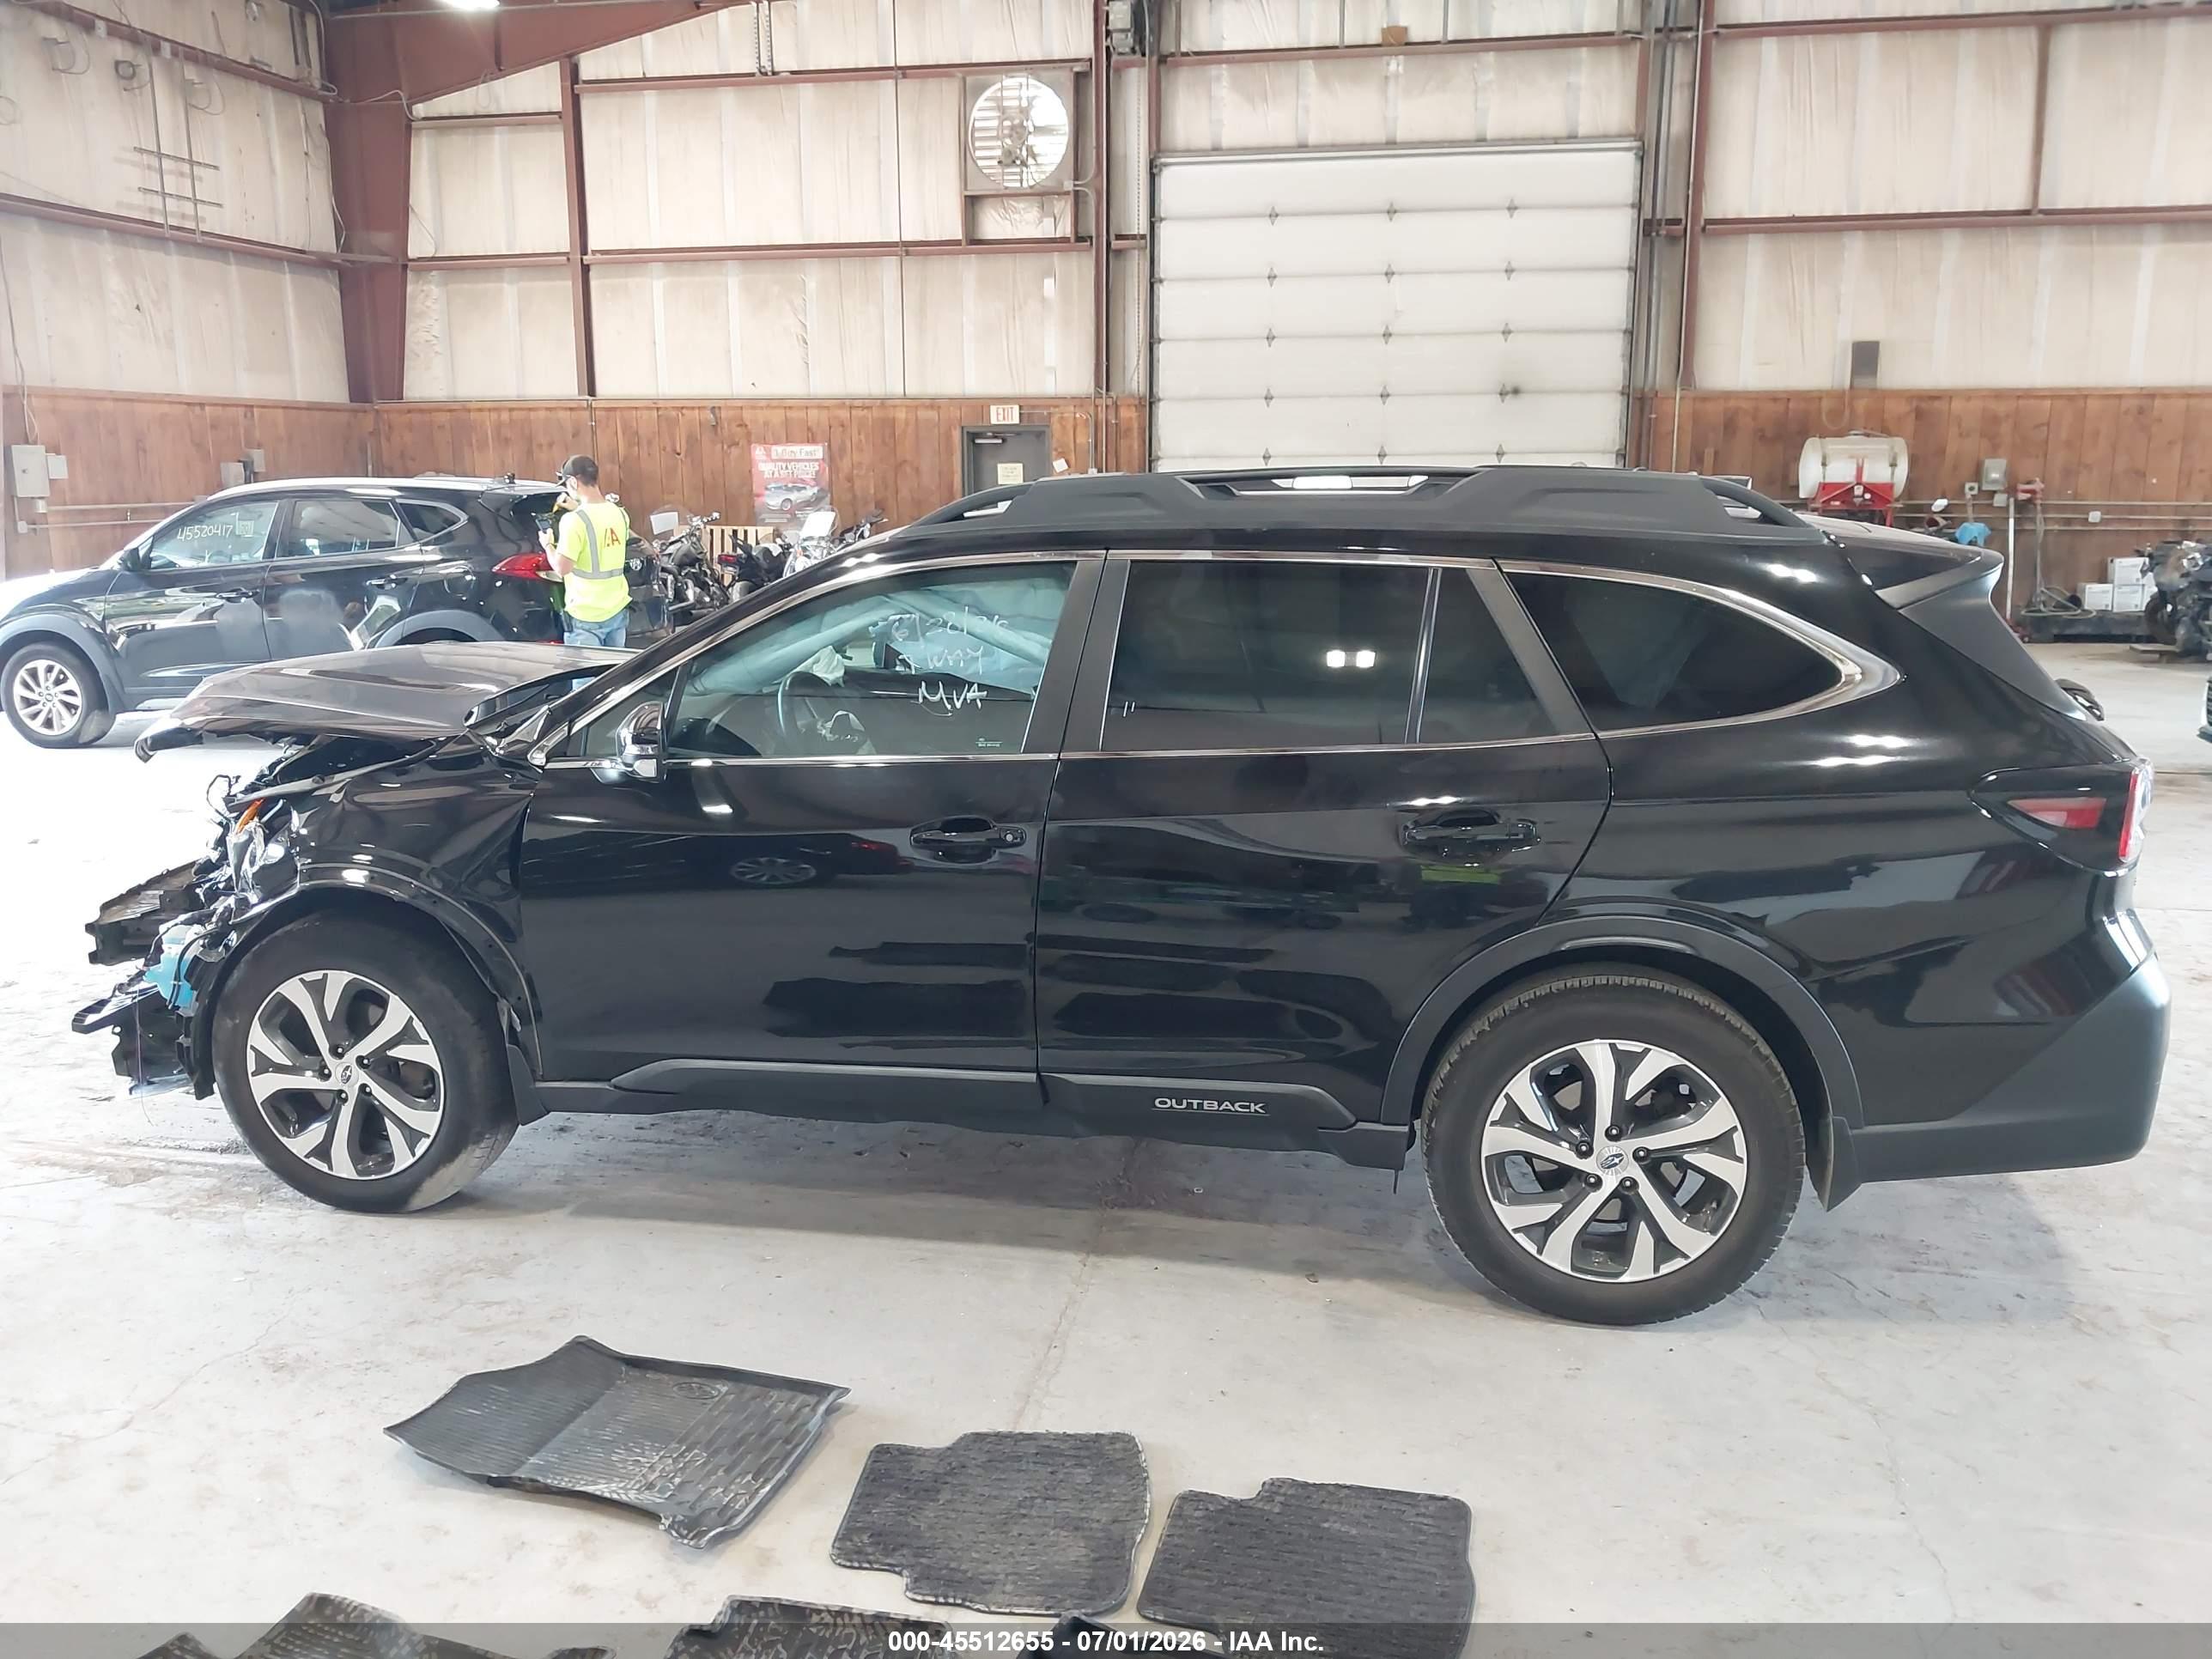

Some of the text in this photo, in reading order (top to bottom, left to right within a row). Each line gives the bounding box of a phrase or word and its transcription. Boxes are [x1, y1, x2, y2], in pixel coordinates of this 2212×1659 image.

[996, 406, 1014, 422] EXIT
[177, 523, 233, 542] 45520417
[918, 680, 988, 711] MVA
[1154, 1097, 1267, 1114] OUTBACK
